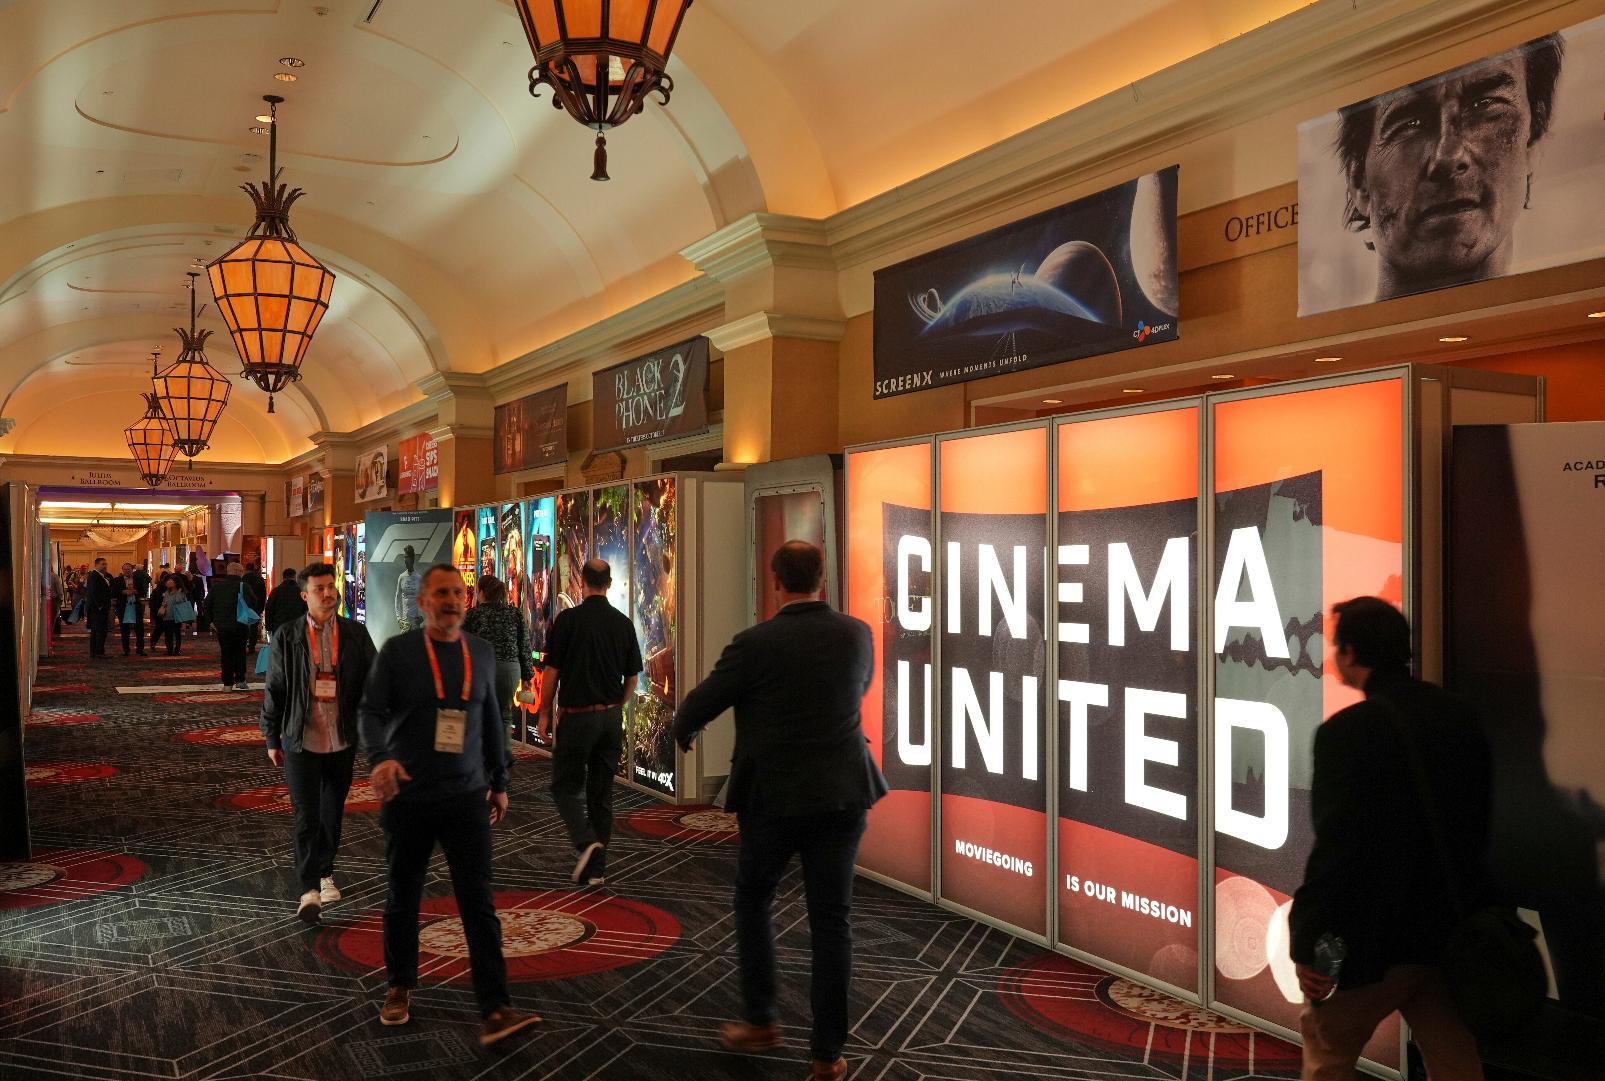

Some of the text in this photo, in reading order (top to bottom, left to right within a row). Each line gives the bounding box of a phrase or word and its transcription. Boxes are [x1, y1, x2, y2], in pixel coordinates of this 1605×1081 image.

[1225, 202, 1298, 242] OFFICE
[615, 359, 664, 401] BLACK
[668, 353, 686, 418] 2
[875, 354, 1027, 395] SCREENX WHERE MOMENTS UNFOLD
[615, 390, 666, 430] PHONE
[80, 478, 121, 486] BALLROOM
[168, 474, 205, 482] OCTAVIUS
[1562, 460, 1605, 471] ACAD
[897, 525, 1290, 659] CINEMA
[897, 660, 1289, 850] UNITED
[635, 765, 647, 777] FEEL
[658, 772, 674, 791] 4DX
[955, 839, 1033, 877] MOVIEGOING
[1066, 874, 1192, 928] IS OUR MISSION
